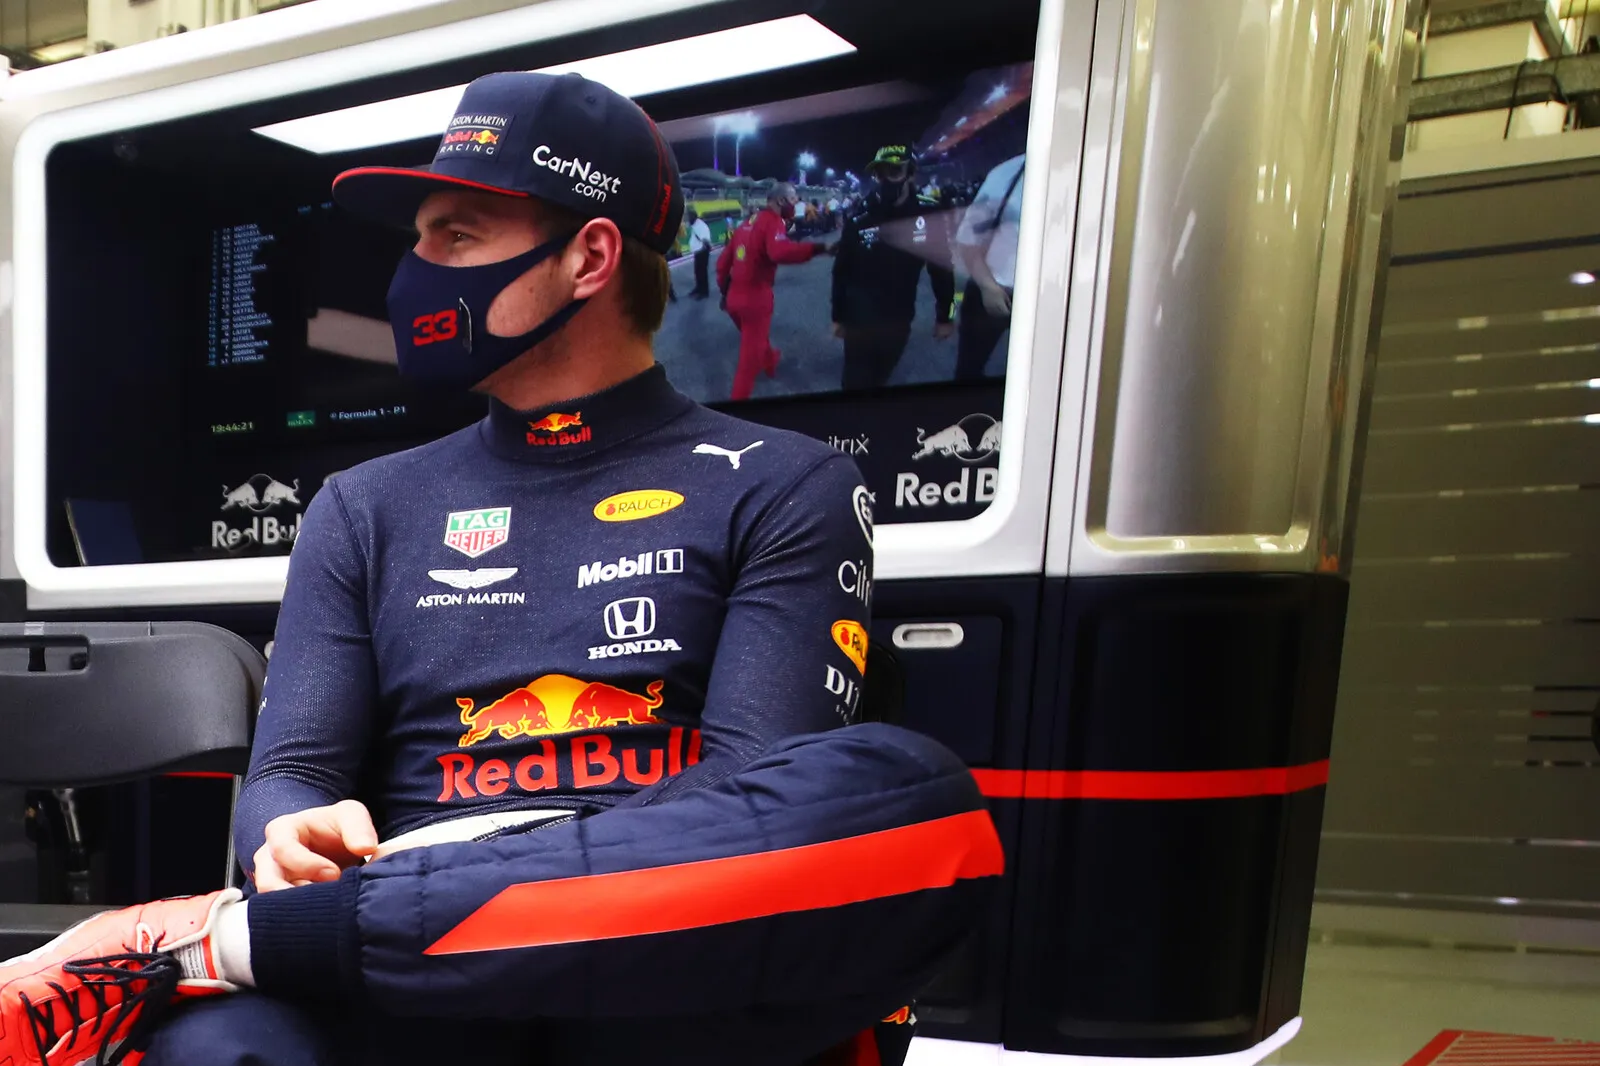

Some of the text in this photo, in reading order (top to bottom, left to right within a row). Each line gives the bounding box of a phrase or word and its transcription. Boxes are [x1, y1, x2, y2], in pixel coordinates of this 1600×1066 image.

[450, 115, 507, 127] ASTON MARTIN
[440, 143, 495, 155] RACING
[533, 145, 621, 194] CarNext
[572, 182, 607, 202] .com
[413, 309, 457, 346] 33
[338, 409, 377, 420] Formula
[394, 406, 407, 415] P1
[210, 421, 254, 433] 19:44:21
[526, 426, 592, 446] Red Bull
[827, 434, 869, 455] itrix
[895, 467, 970, 508] Red
[618, 498, 672, 514] RAUCH
[211, 512, 302, 549] Red Bul
[453, 511, 505, 530] TAG
[448, 530, 505, 554] HEUER
[577, 552, 653, 588] Mobil
[416, 592, 525, 608] ASTON MARTIN
[588, 639, 682, 660] HONDA
[436, 727, 701, 803] Red Bull
